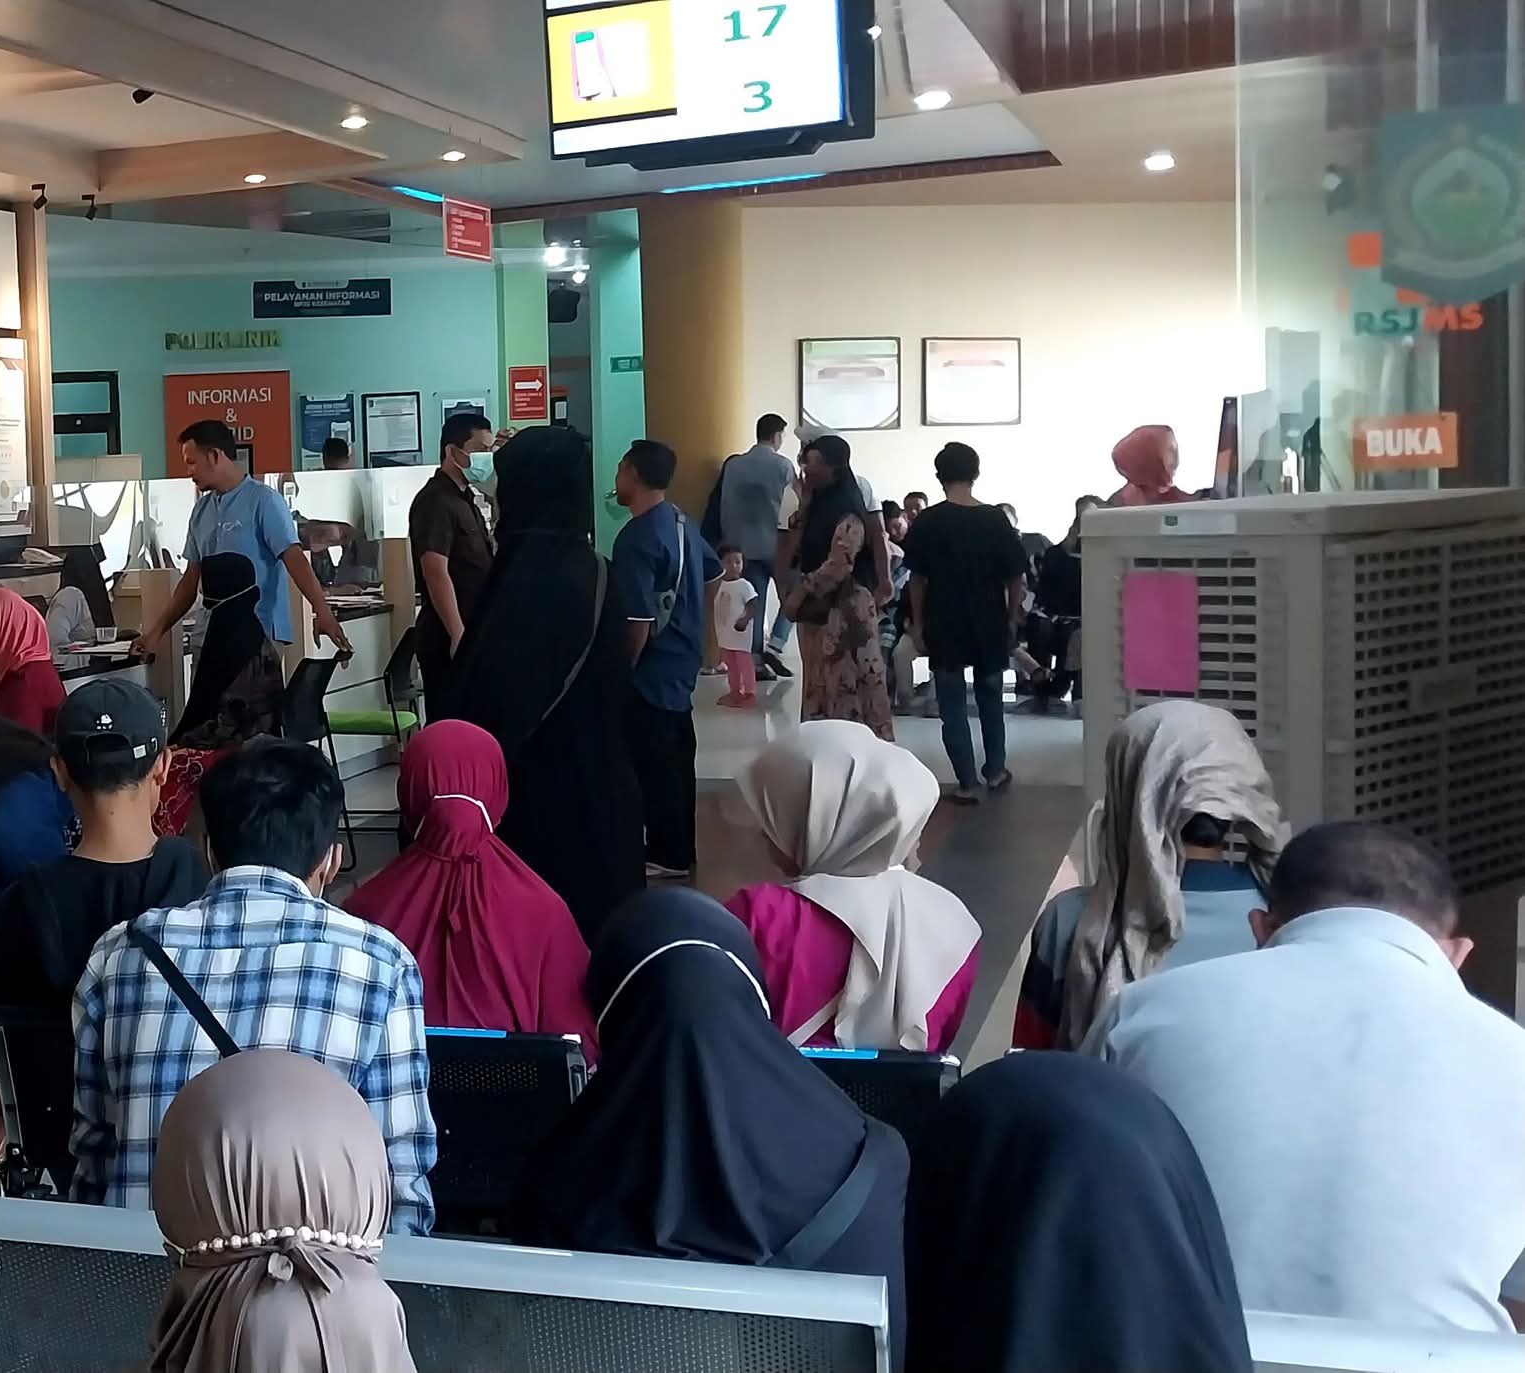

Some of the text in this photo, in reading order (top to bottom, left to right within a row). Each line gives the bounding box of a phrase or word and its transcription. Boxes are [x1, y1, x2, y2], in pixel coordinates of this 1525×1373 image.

[723, 4, 787, 42] 17
[743, 80, 773, 113] 3
[264, 290, 380, 302] PELAYANAN INFORMASI
[187, 387, 272, 405] INFORMASI
[225, 408, 238, 422] &
[1366, 427, 1443, 457] BUKA
